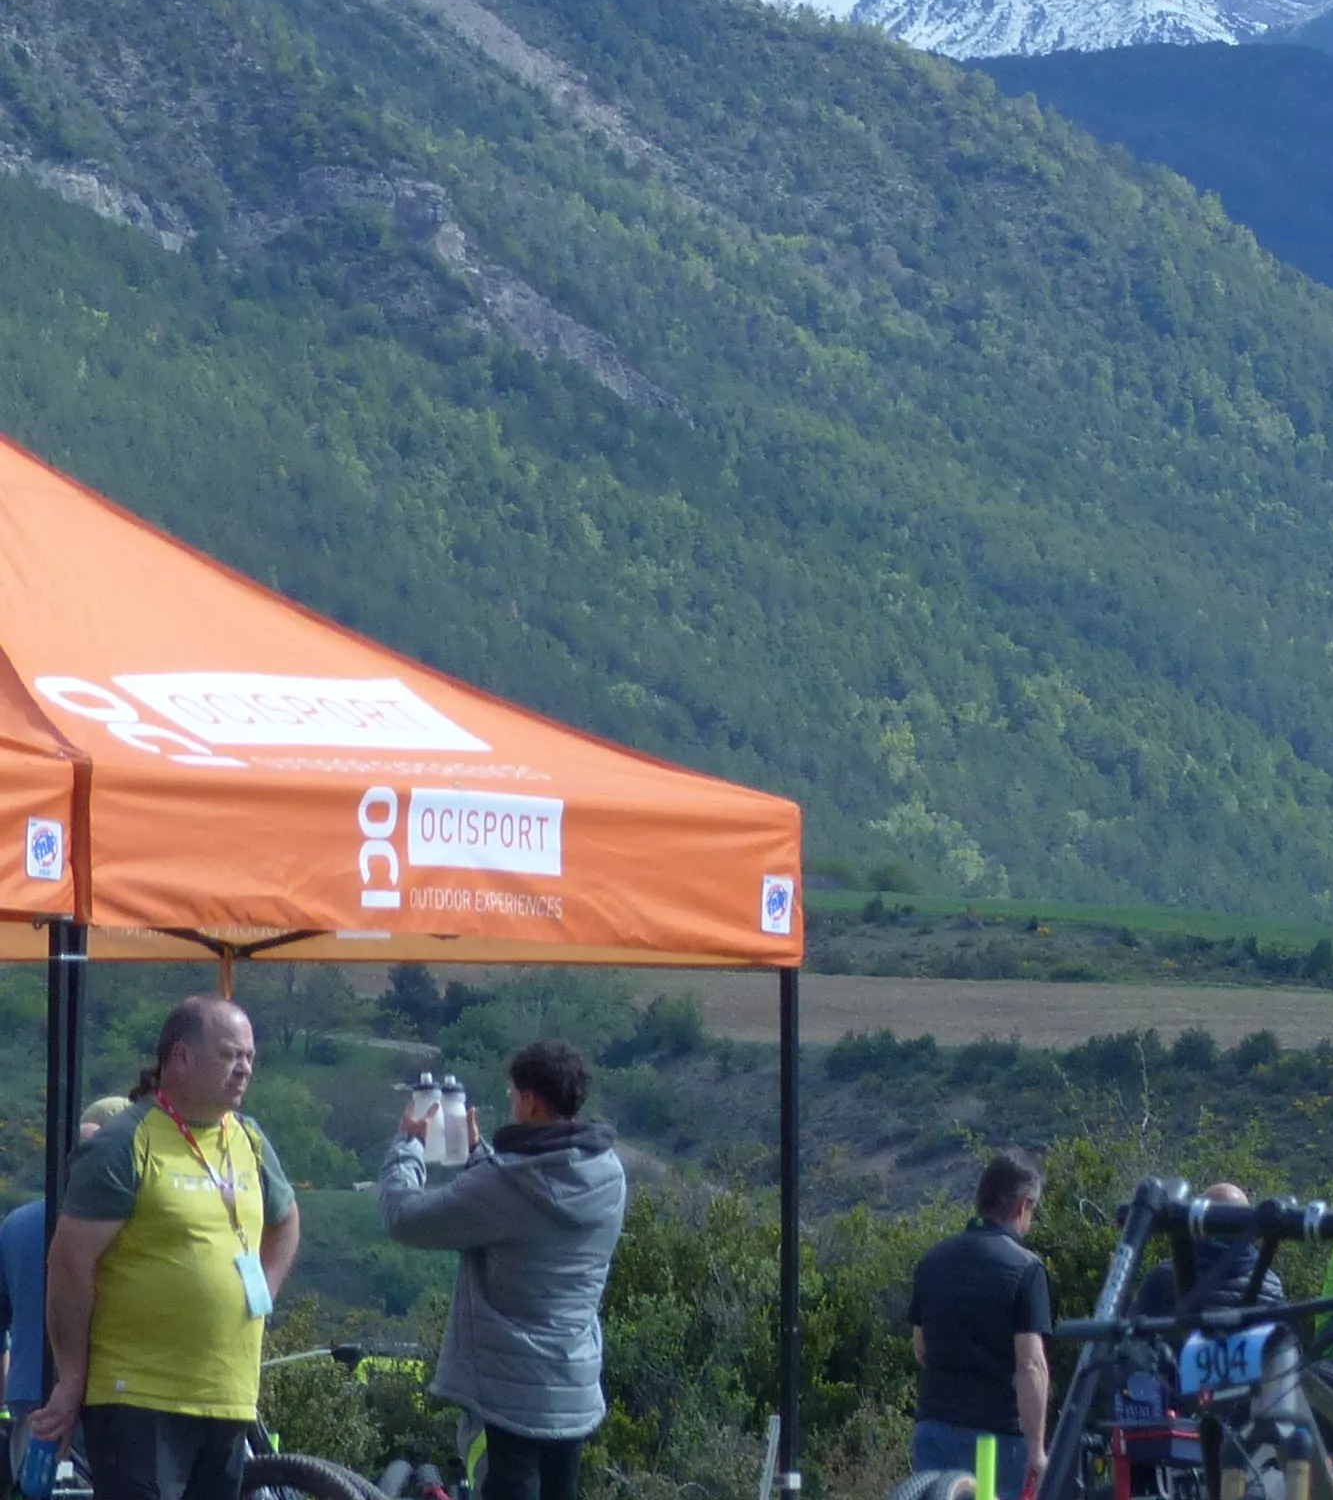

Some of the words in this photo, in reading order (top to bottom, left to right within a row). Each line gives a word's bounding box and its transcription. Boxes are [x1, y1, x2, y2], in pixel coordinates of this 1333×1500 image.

[168, 692, 428, 732] OCISPORT
[358, 786, 401, 908] OCI
[420, 807, 549, 852] OCISPORT
[410, 887, 471, 911] OUTDOOR
[475, 891, 564, 919] EXPERIENCES
[1196, 1340, 1248, 1384] 904
